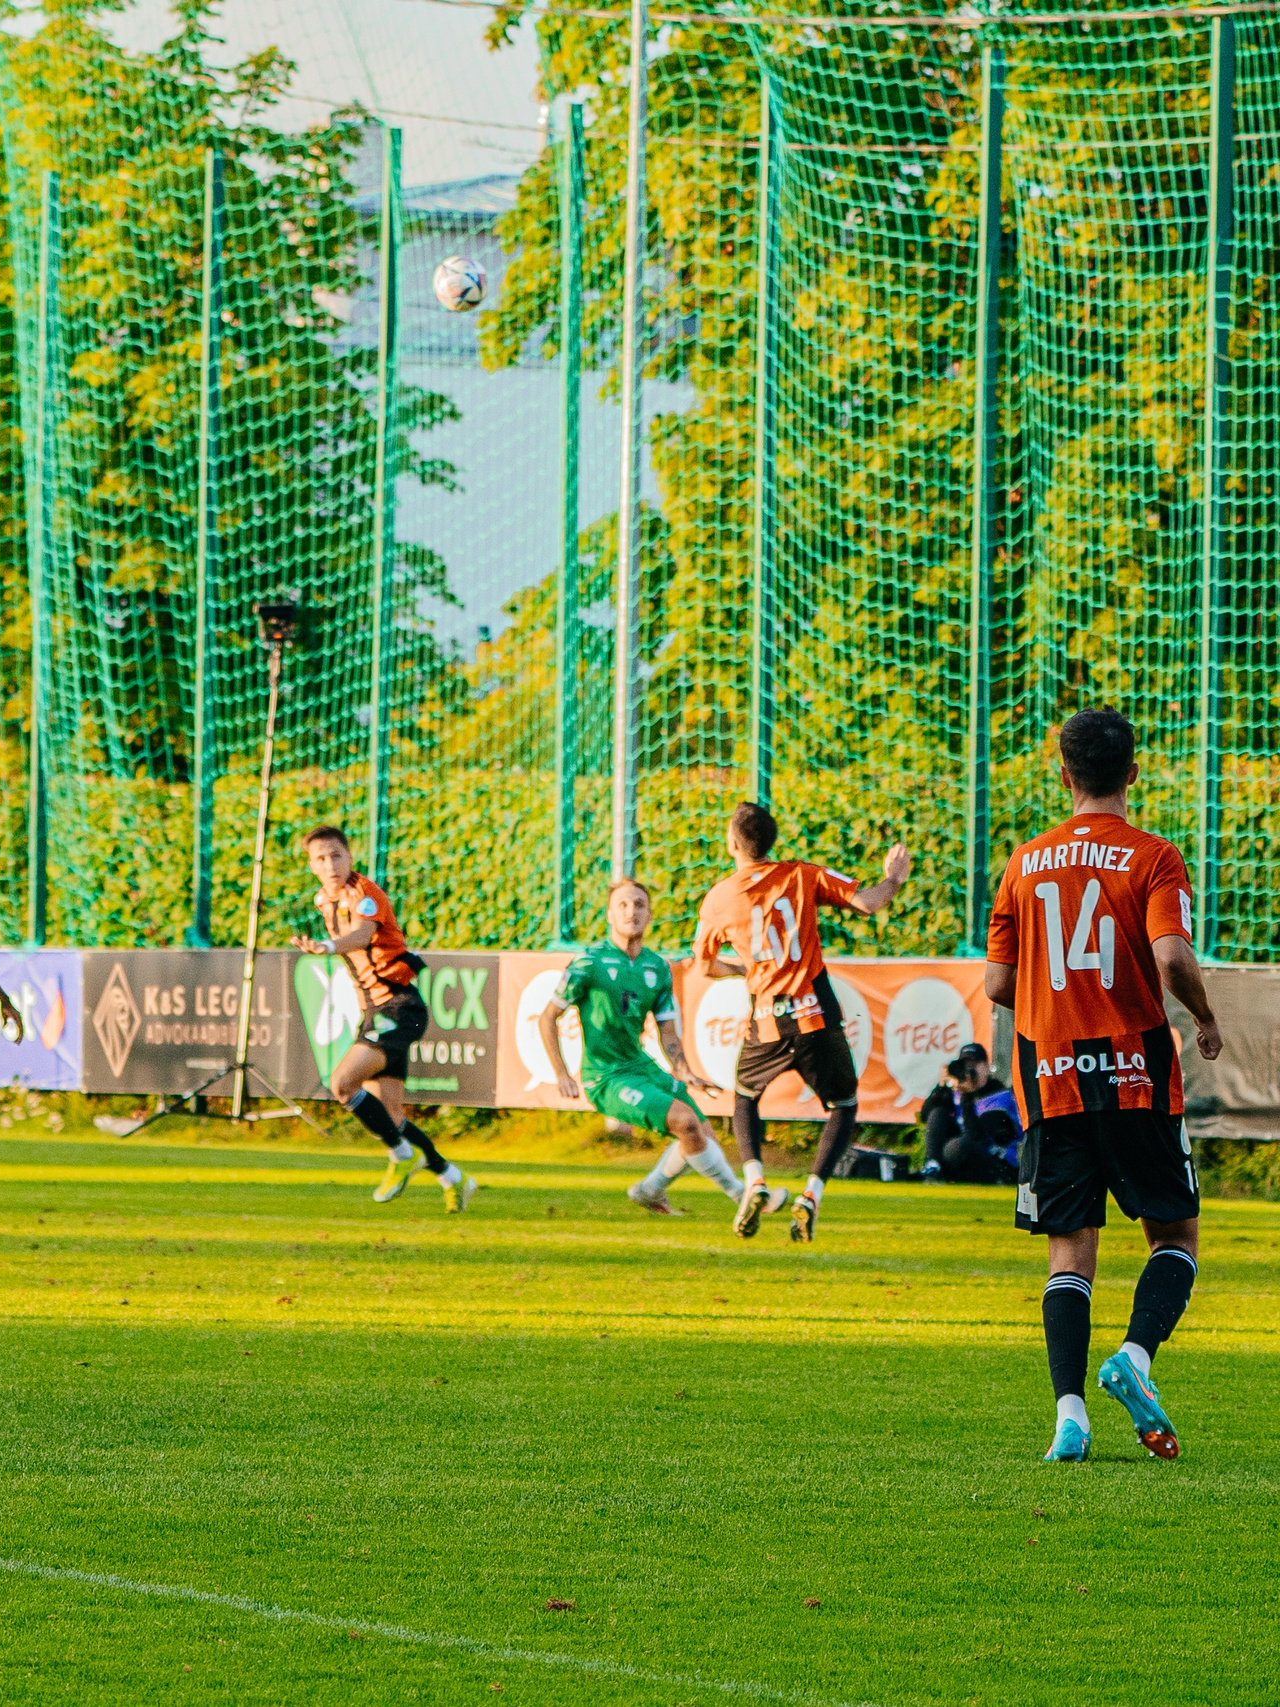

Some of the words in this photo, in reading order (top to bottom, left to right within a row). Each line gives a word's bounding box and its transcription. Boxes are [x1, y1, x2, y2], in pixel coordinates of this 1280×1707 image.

[1021, 841, 1135, 877] MARTINEZ
[751, 896, 803, 969] 41
[1034, 878, 1116, 992] 14
[194, 984, 274, 1018] LEGL
[411, 965, 490, 1031] CX
[753, 993, 819, 1021] APOLLO
[408, 1040, 477, 1066] TWORK
[894, 1019, 960, 1055] TERE
[1034, 1051, 1146, 1079] APOLLO
[1184, 1159, 1199, 1194] 1
